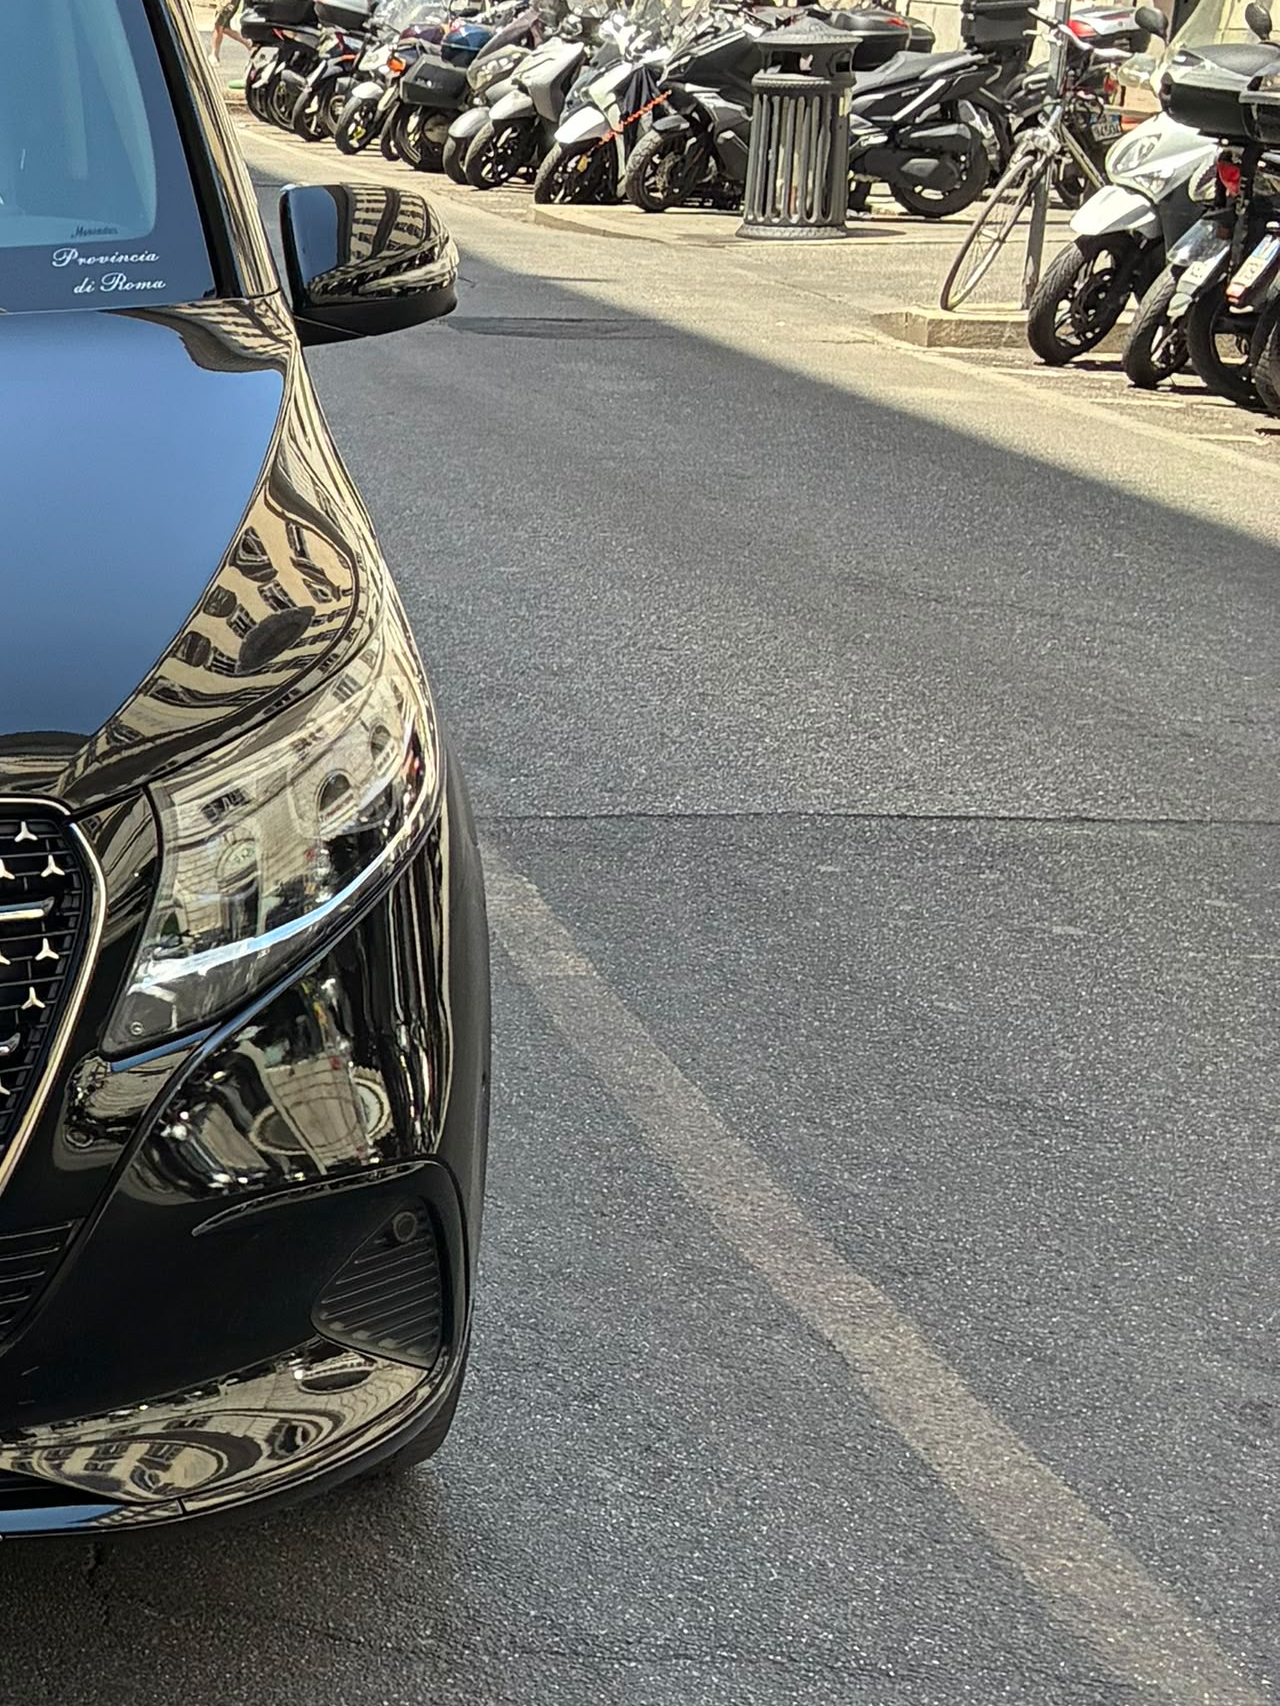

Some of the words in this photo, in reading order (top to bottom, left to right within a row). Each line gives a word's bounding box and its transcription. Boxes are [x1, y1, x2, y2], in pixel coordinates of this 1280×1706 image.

[51, 247, 160, 267] Provincia
[73, 276, 96, 294] di
[99, 272, 167, 292] Roma
